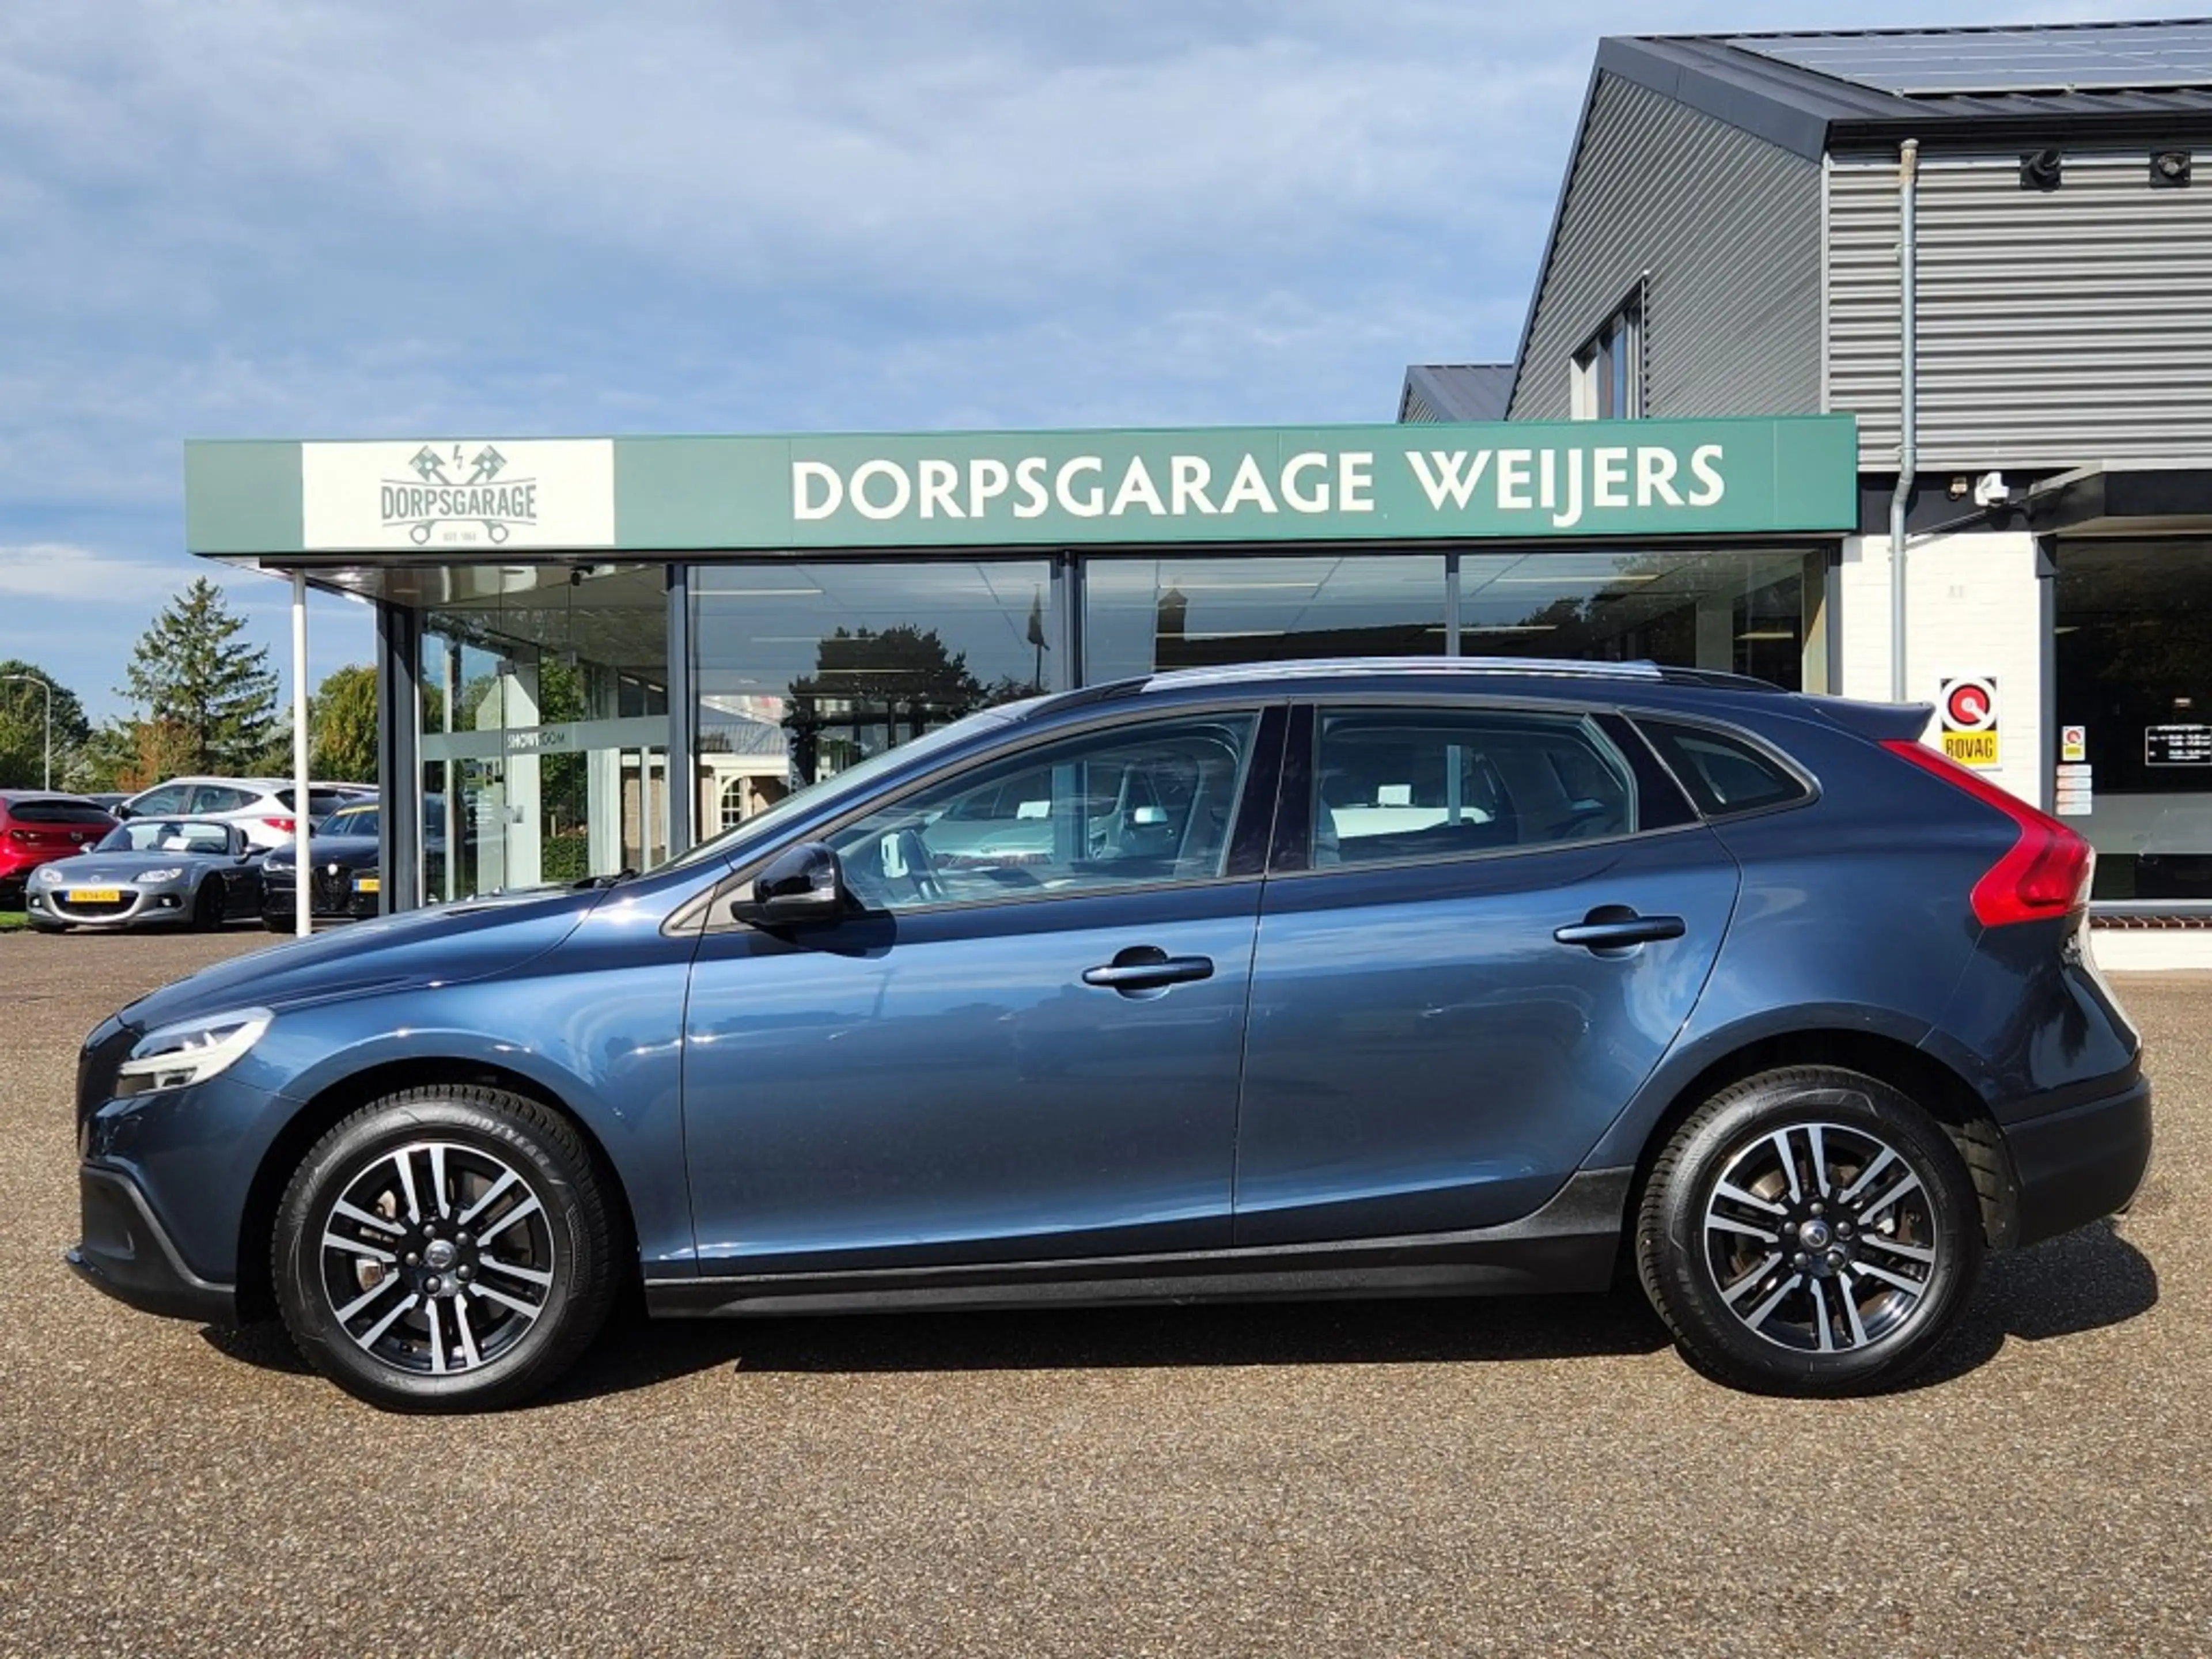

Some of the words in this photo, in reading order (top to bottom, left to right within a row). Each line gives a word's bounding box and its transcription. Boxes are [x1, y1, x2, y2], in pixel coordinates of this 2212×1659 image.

[381, 485, 537, 520] DORPSGARAGE
[793, 453, 1374, 520] DORPSGARAGE
[1404, 445, 1725, 527] WEIJERS
